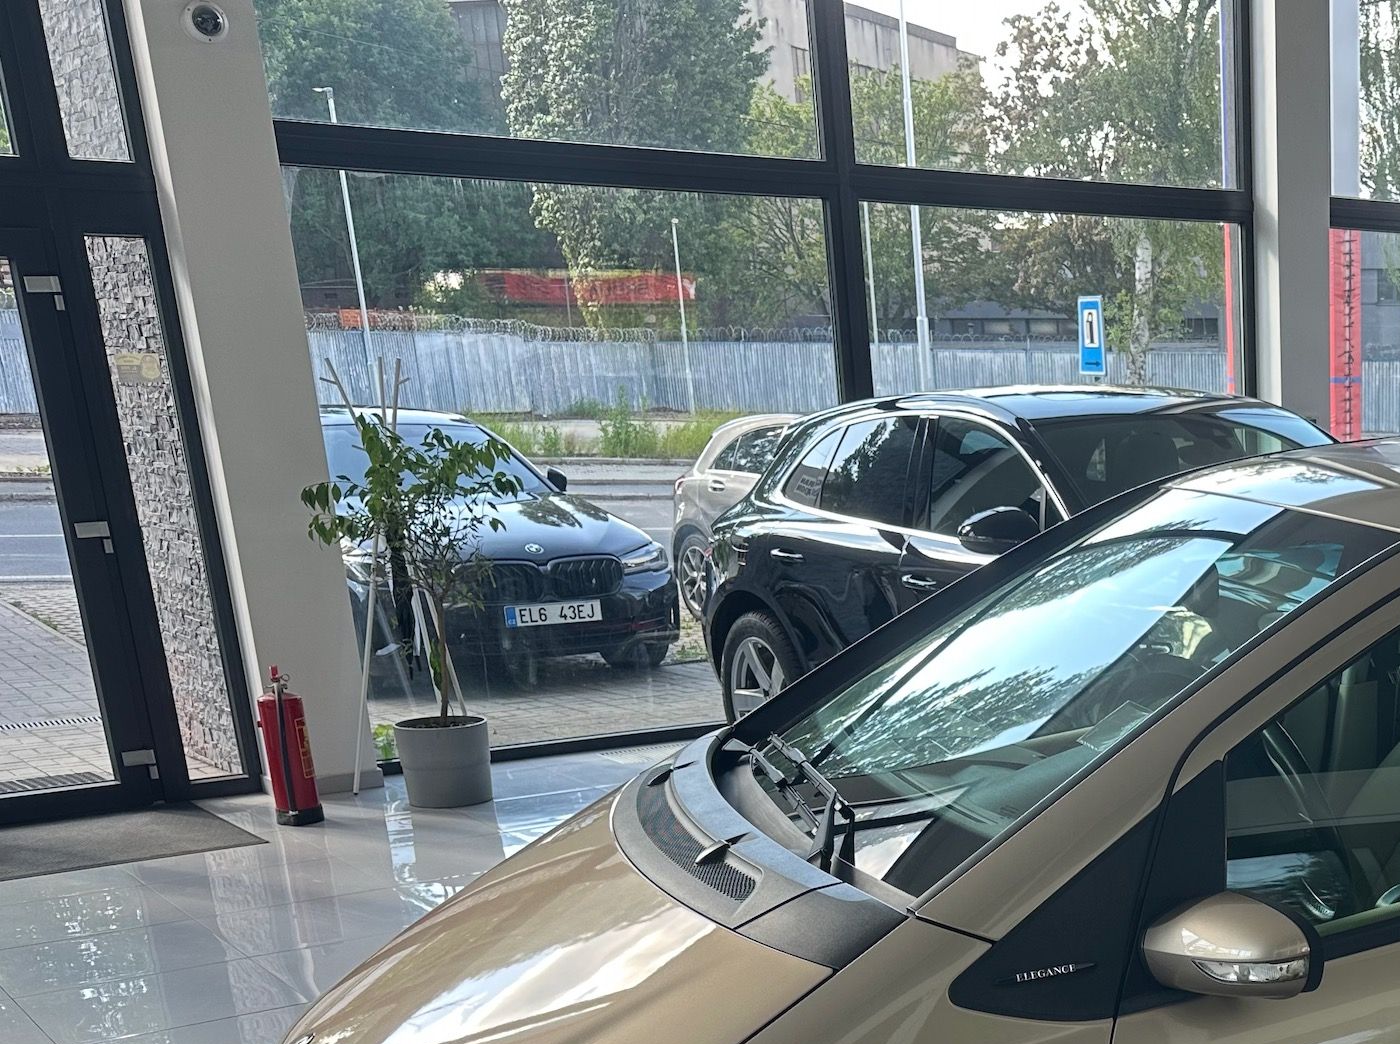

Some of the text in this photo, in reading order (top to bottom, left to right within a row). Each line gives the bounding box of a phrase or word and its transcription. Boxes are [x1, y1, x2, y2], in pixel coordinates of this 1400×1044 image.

[518, 603, 595, 624] EL6 43EJ
[1015, 963, 1077, 982] ELEGANCE
